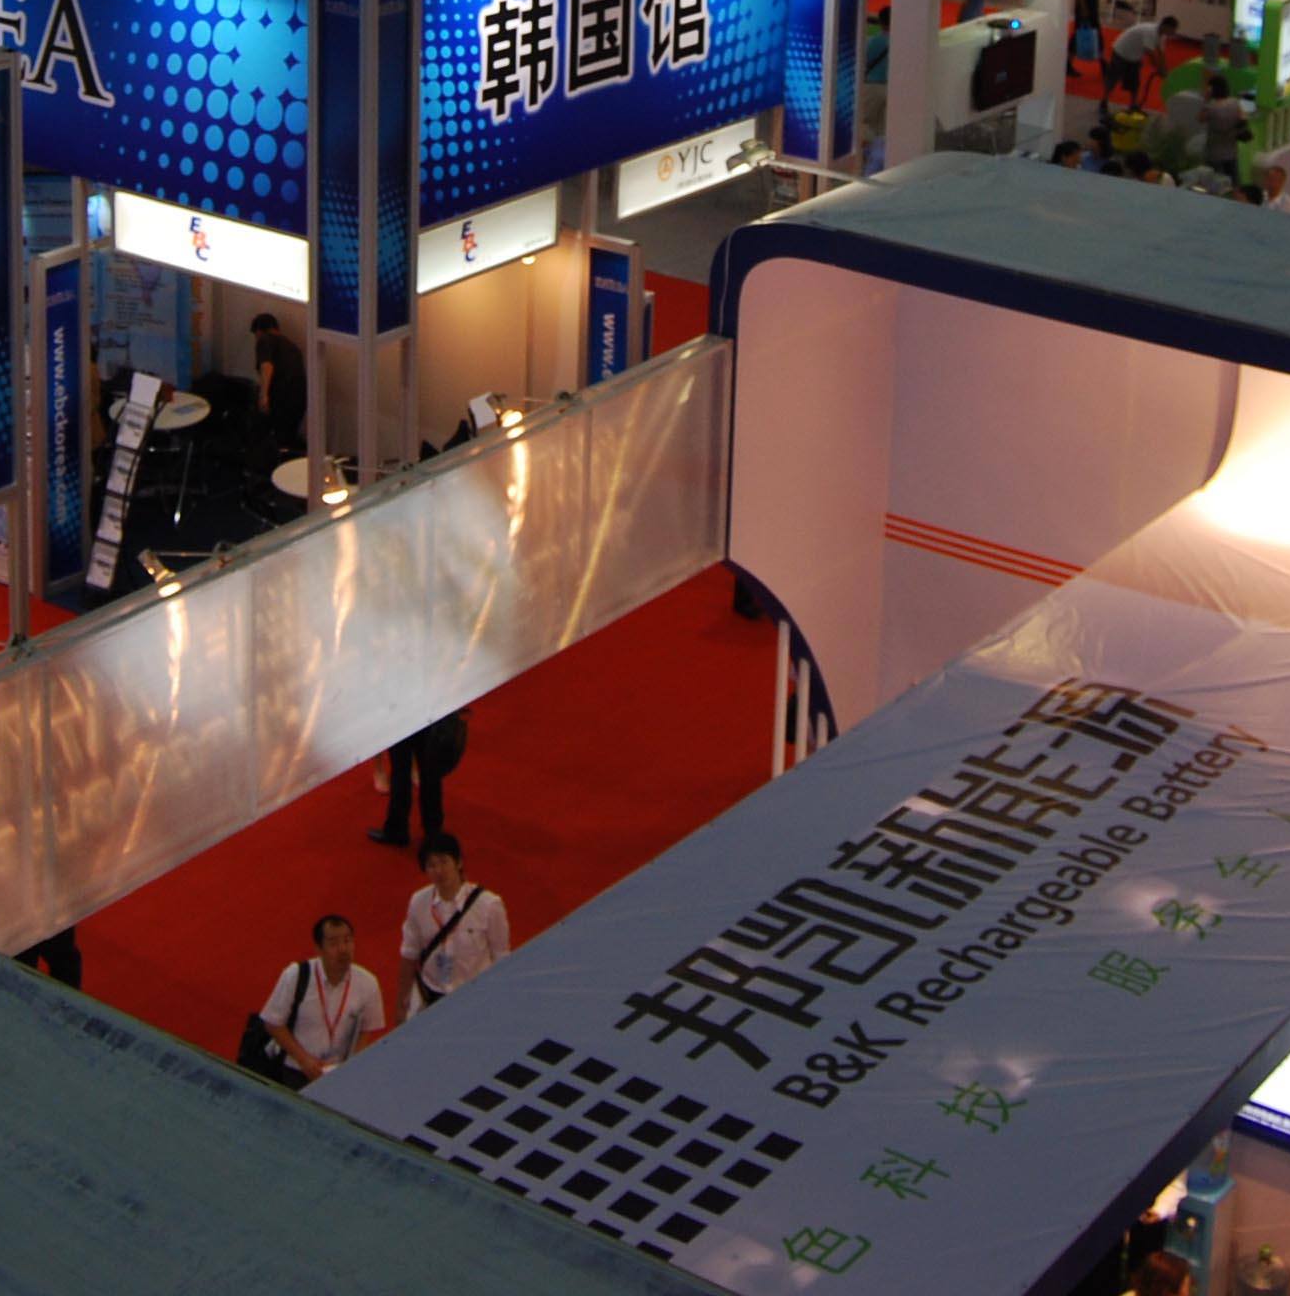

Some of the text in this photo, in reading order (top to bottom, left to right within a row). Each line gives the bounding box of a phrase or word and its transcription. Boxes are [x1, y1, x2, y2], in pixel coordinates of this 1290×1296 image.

[677, 140, 714, 174] YJC
[773, 723, 1271, 1108] B&K Rechargeable Battery
